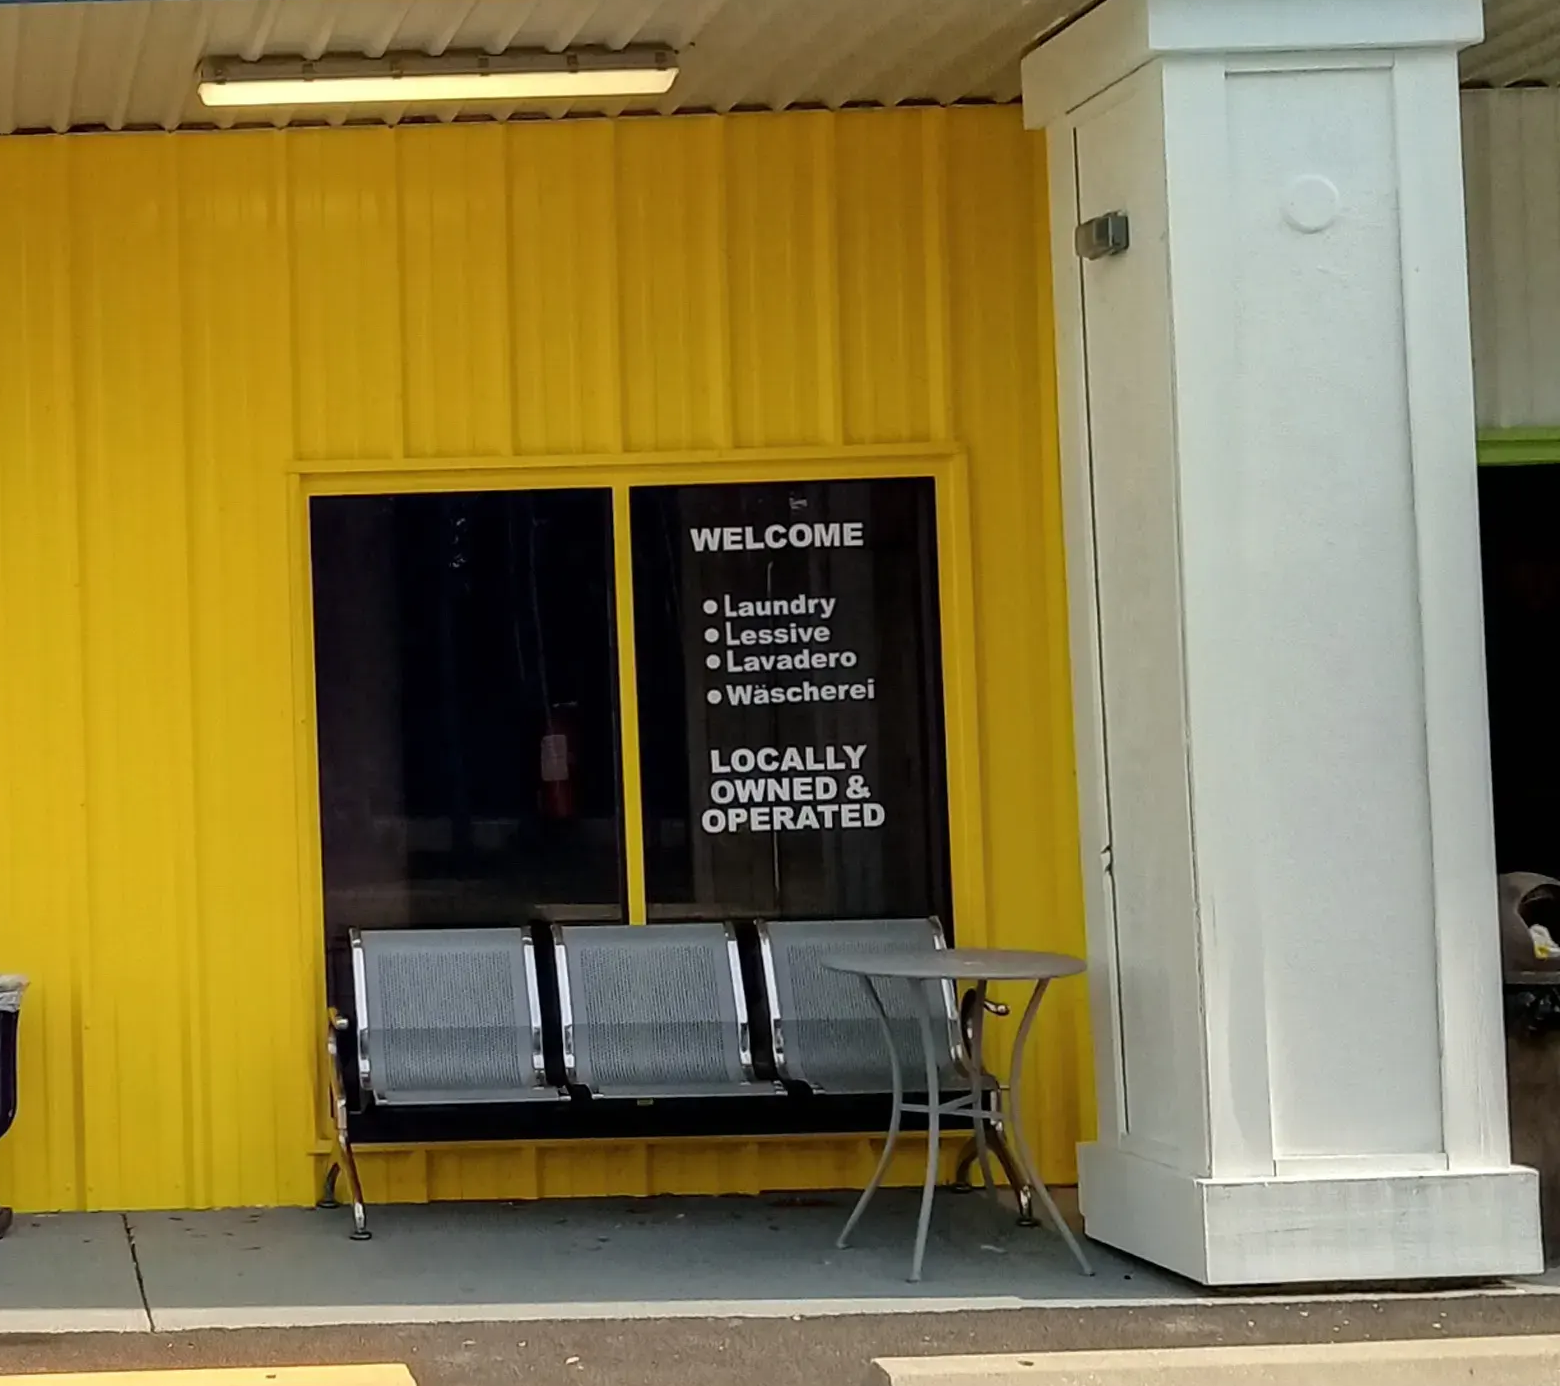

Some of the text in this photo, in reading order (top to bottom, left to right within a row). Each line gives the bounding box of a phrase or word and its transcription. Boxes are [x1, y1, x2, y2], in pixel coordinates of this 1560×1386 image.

[690, 522, 864, 552] WELCOME
[724, 594, 836, 618] Laundry
[725, 621, 831, 646] Lessive
[726, 649, 857, 673] Lavadero
[726, 679, 876, 706] Wäscherei
[710, 745, 868, 773] LOCALLY
[710, 775, 871, 804] OWNED &
[701, 803, 886, 833] OPERATED
